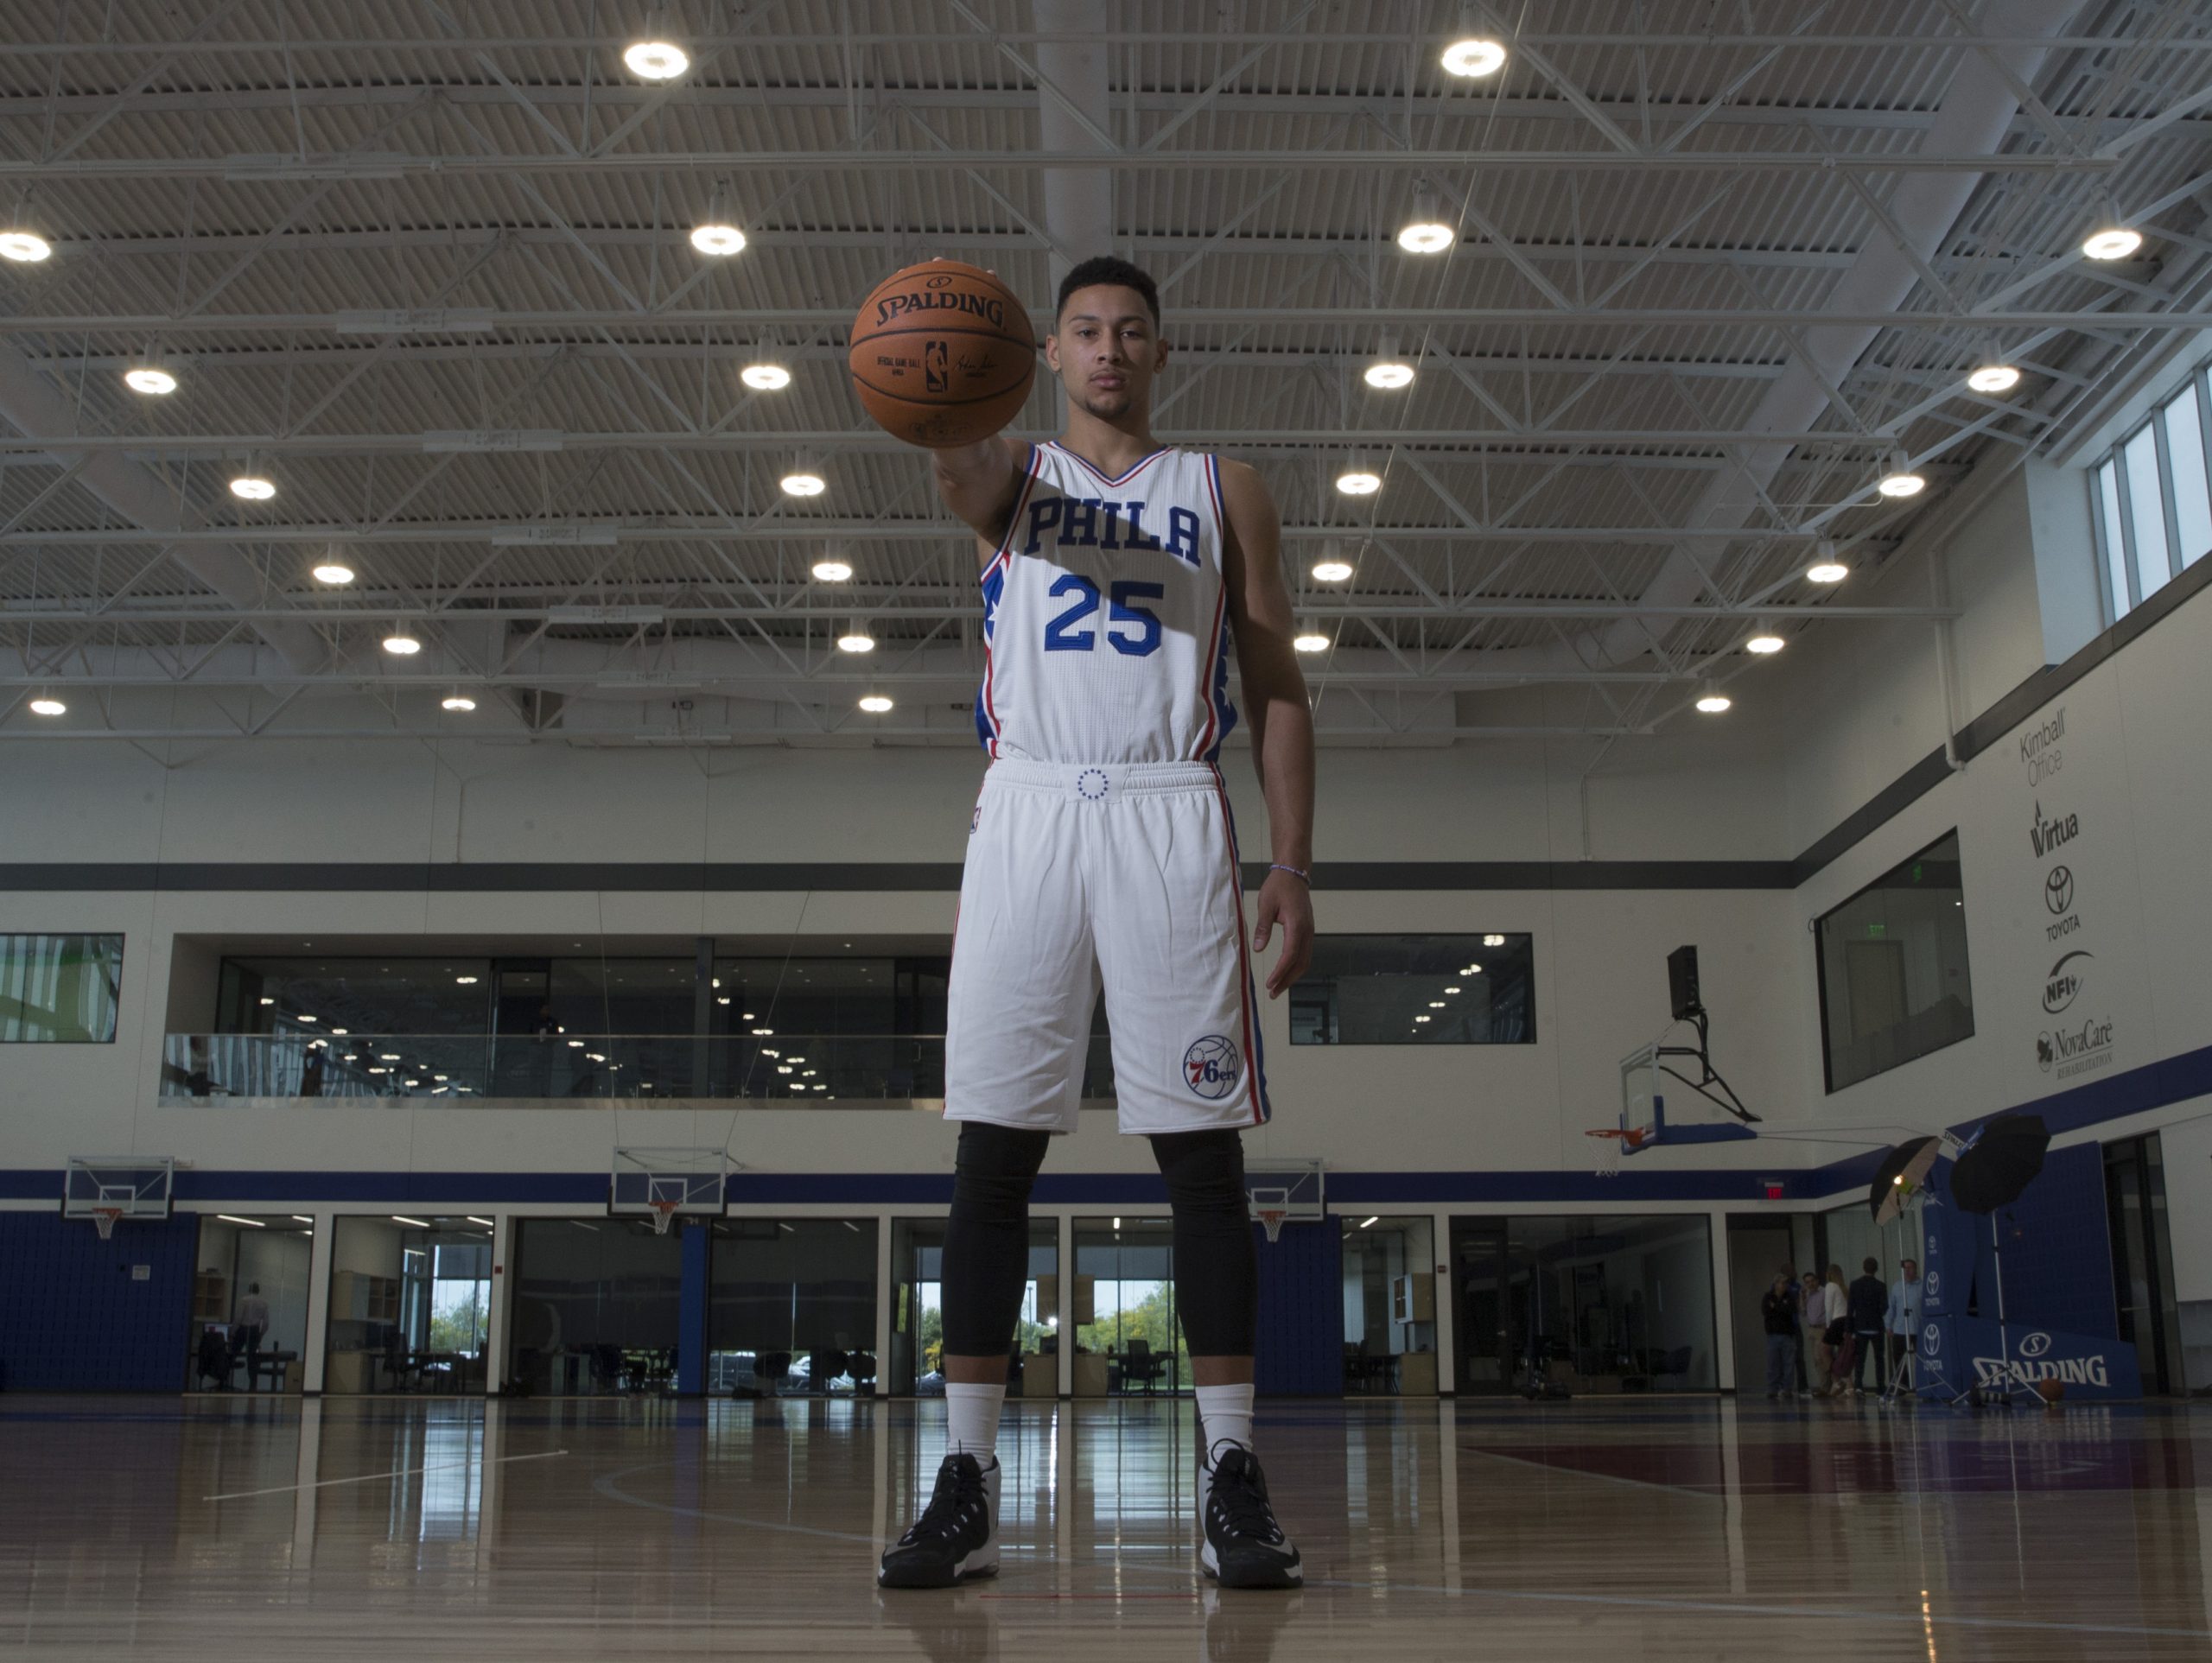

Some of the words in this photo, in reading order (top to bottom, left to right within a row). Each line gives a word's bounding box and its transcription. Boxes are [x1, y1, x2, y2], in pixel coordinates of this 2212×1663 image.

[876, 292, 1003, 327] SPALDING
[1024, 497, 1201, 567] PHILA
[1044, 574, 1164, 657] 25
[2020, 708, 2065, 763] Kimball
[2028, 750, 2063, 787] Office
[2031, 812, 2079, 858] Virtua
[2046, 914, 2081, 943] TOYOTA
[2046, 976, 2070, 1004] NFI
[2055, 1019, 2113, 1060] NovaCare
[1189, 1059, 1237, 1084] 76ers
[2057, 1052, 2113, 1080] REHABILITATION
[1942, 1131, 1964, 1148] SPALD
[1973, 1355, 2108, 1388] SPALDING
